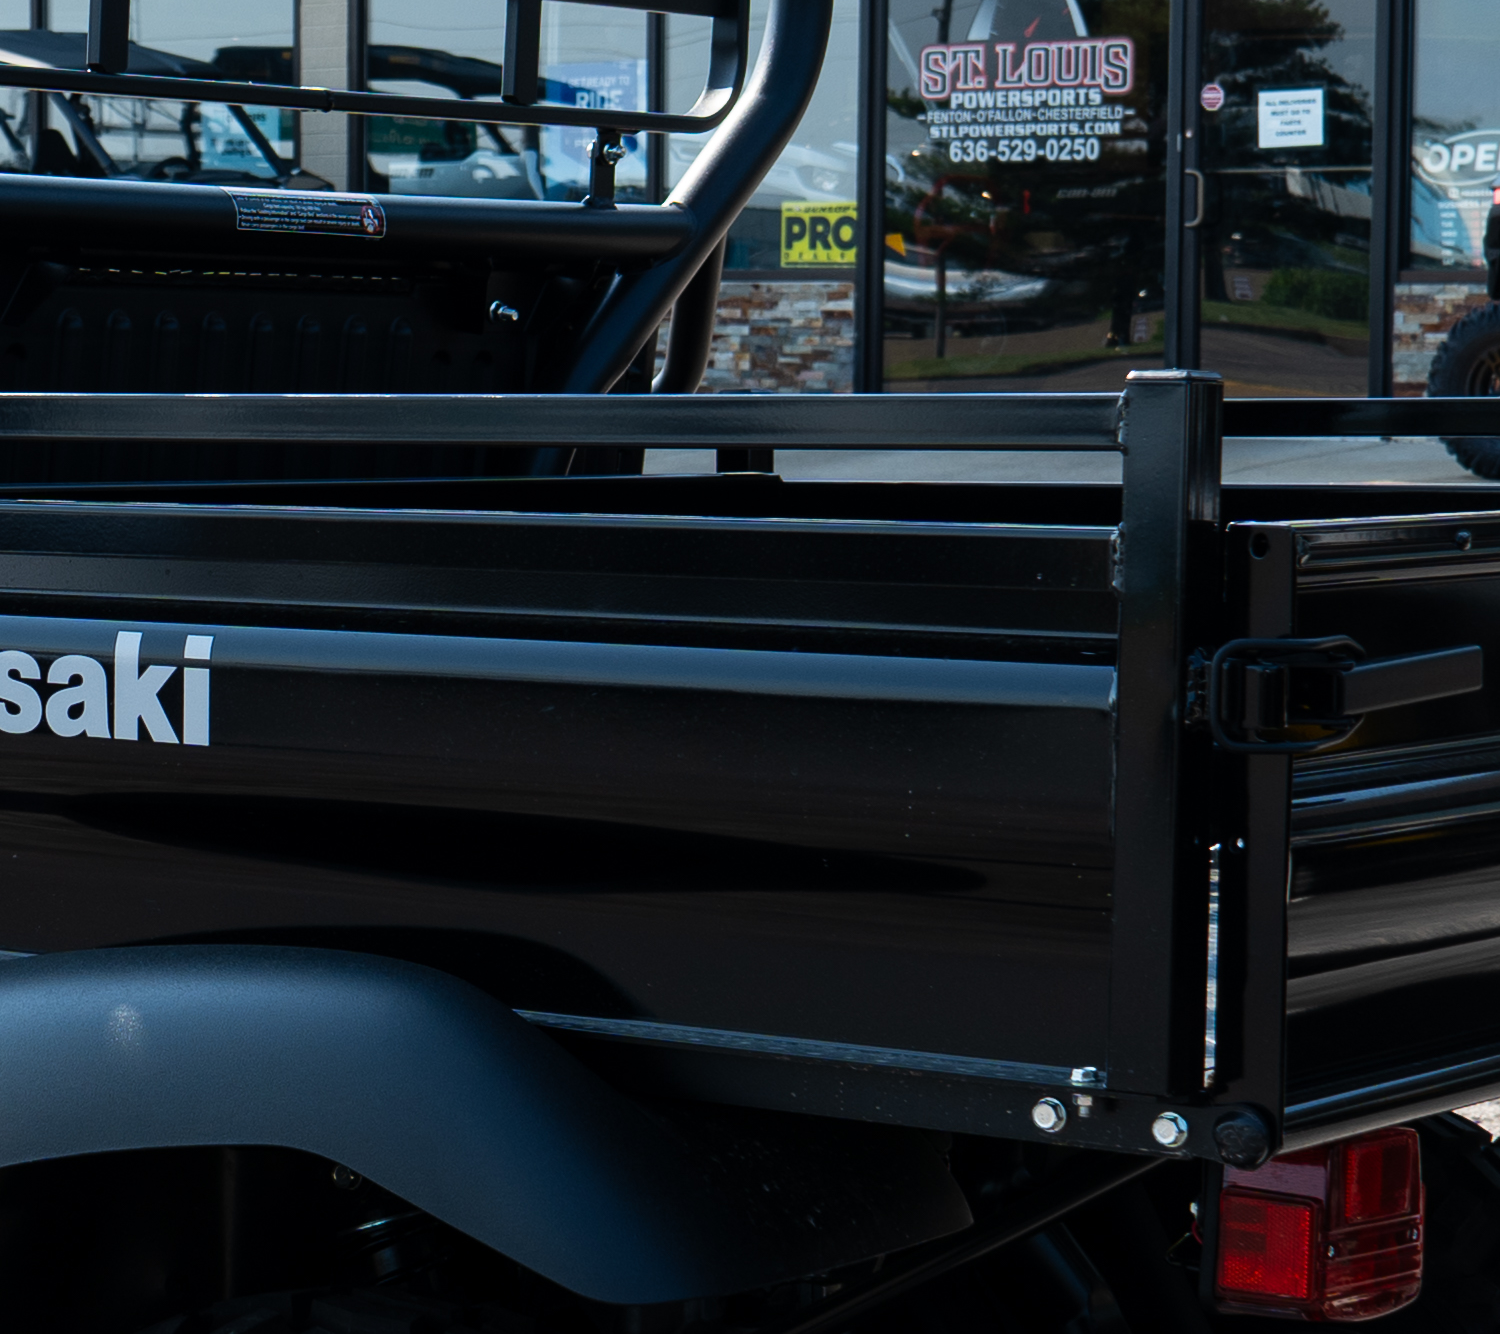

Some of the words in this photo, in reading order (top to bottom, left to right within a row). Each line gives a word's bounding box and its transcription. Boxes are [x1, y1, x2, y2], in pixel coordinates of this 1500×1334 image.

[921, 44, 987, 100] ST.
[994, 38, 1134, 94] LOUIS
[950, 88, 1102, 109] POWERSPORTS
[929, 121, 1121, 139] STLPOWERSPORTS.COM
[949, 138, 1100, 163] 636-529-0250
[784, 215, 857, 252] PRO
